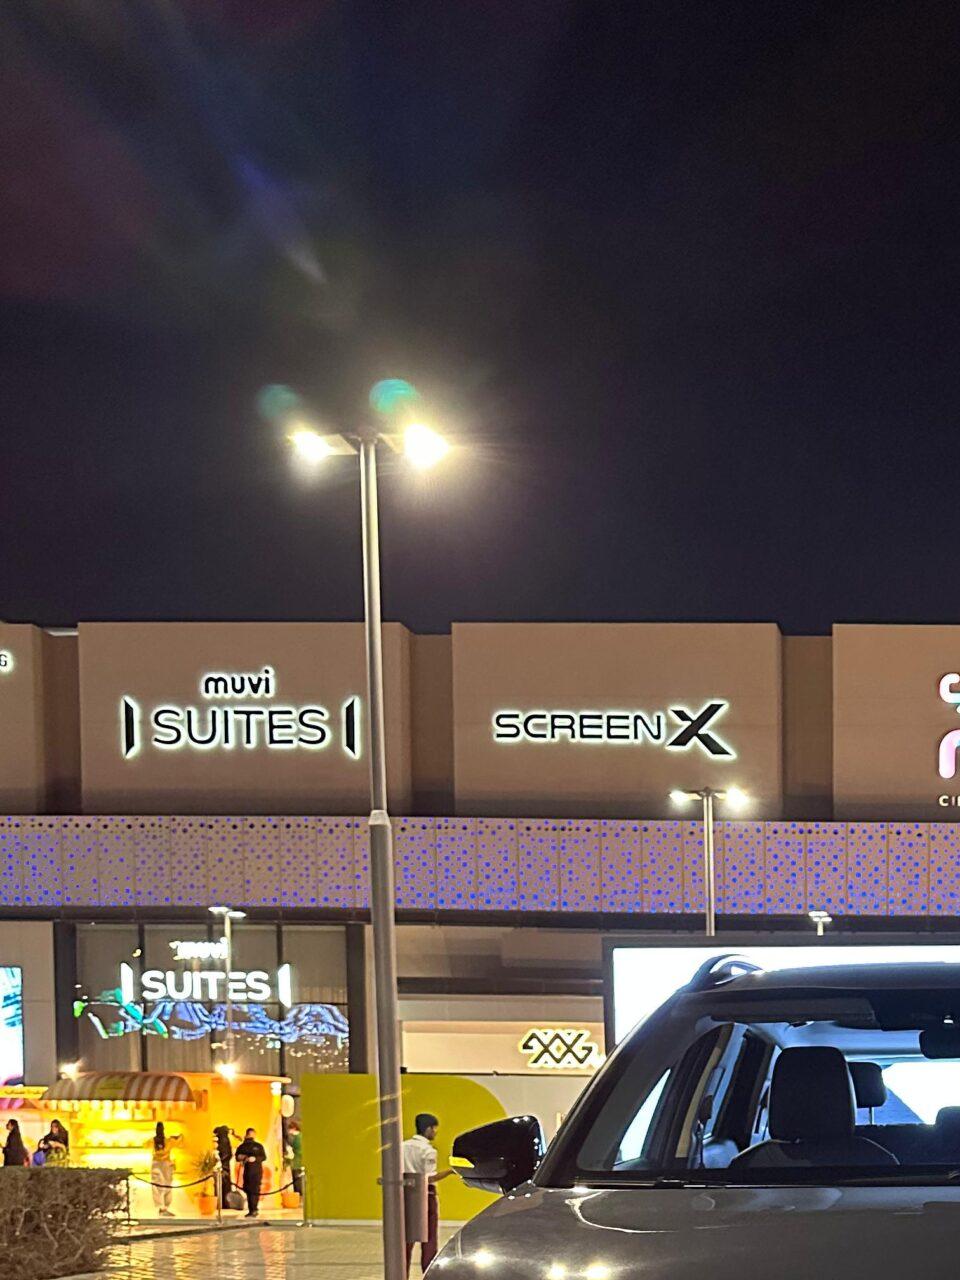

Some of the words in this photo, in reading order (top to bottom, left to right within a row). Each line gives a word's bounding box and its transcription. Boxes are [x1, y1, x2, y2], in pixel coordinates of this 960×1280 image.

[203, 668, 271, 695] muvi
[153, 708, 328, 746] SUITES
[141, 970, 272, 1001] SUITES
